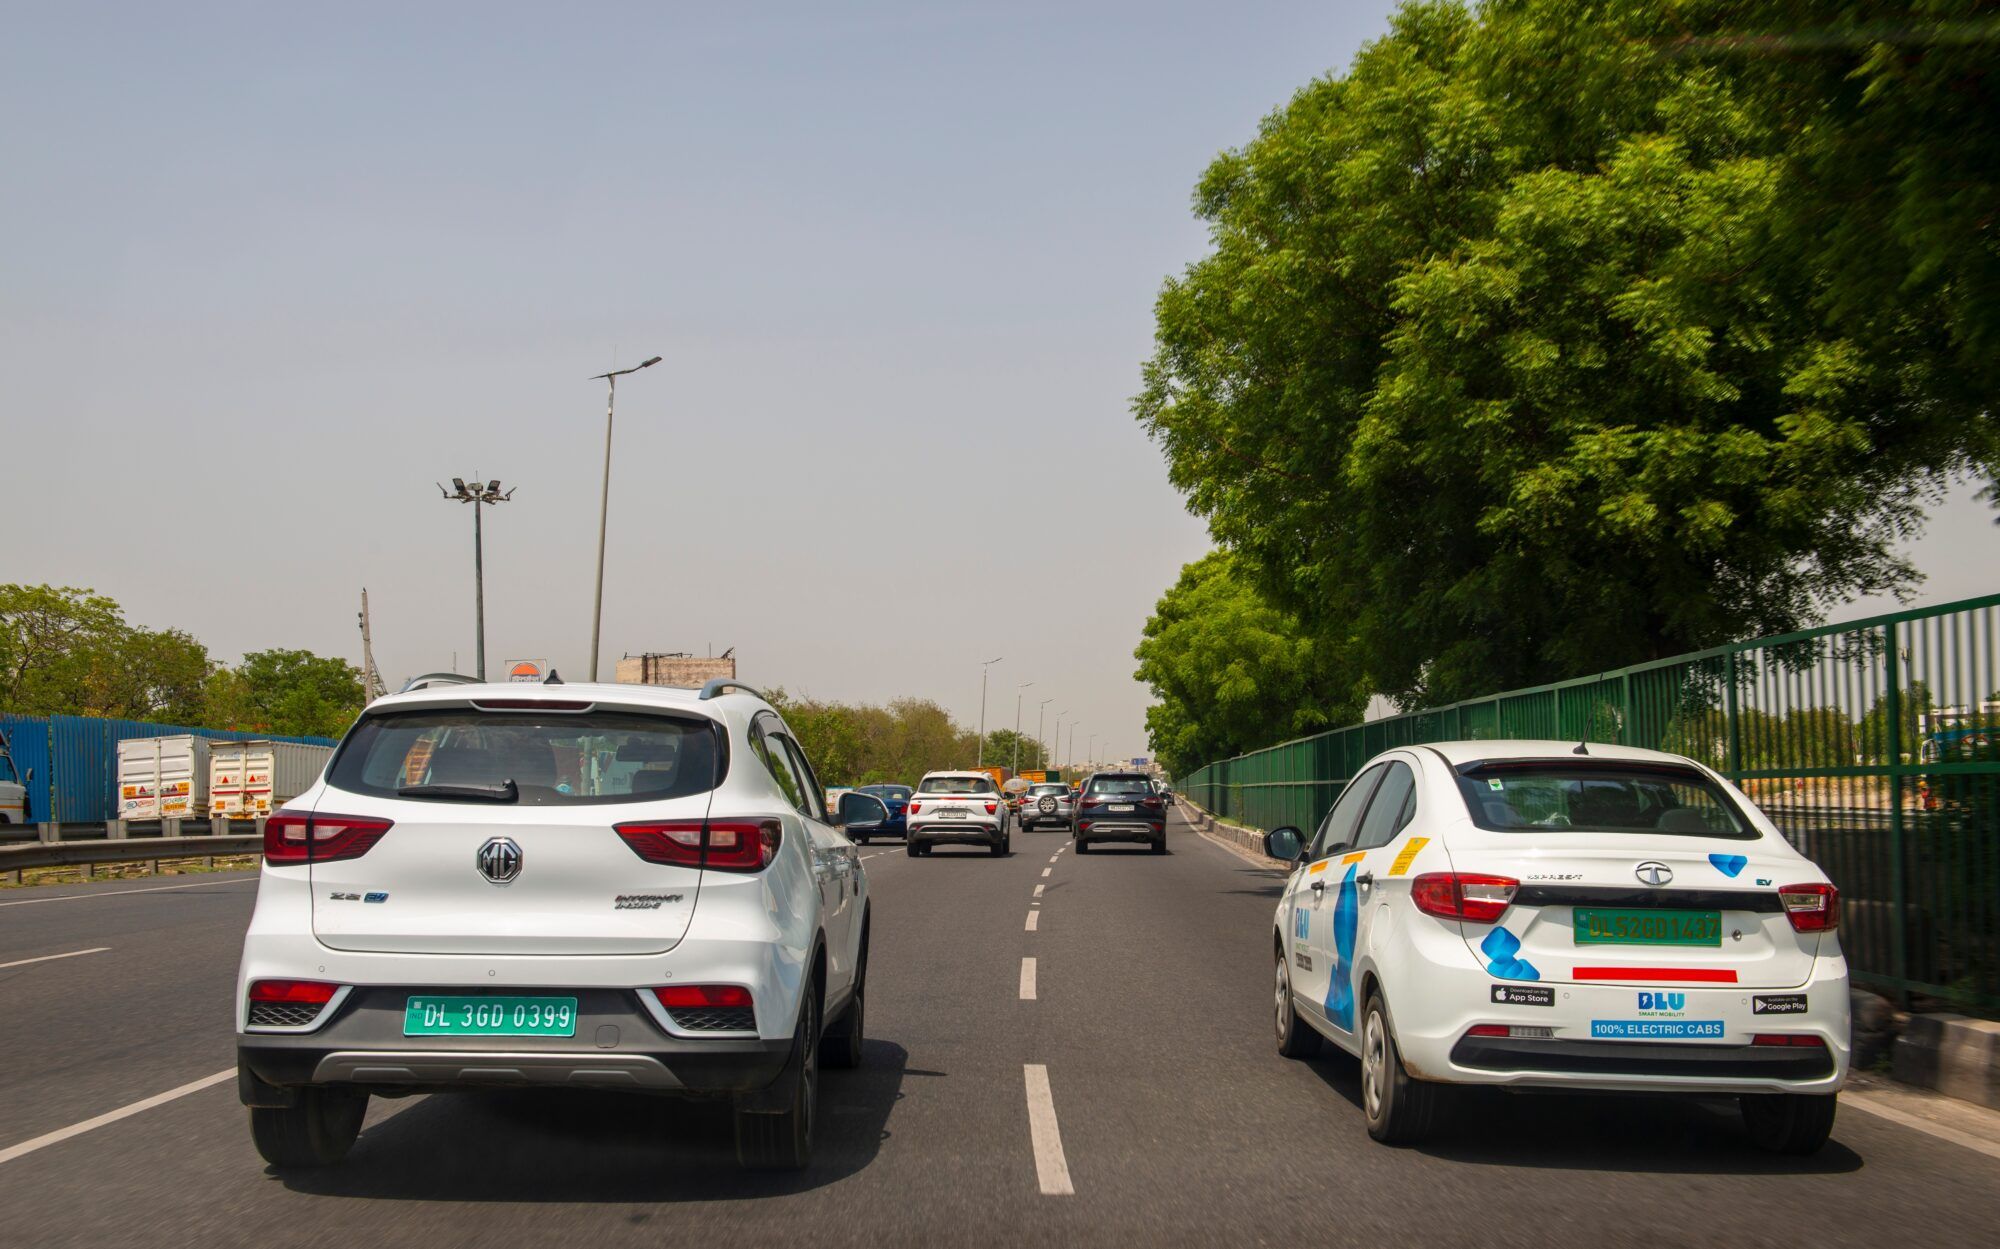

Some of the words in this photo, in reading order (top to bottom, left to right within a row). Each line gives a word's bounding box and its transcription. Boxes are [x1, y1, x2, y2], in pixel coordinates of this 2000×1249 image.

[483, 843, 517, 879] MG
[1509, 994, 1526, 1002] App
[1638, 992, 1685, 1010] BLU
[1767, 1003, 1791, 1011] Google
[1792, 1002, 1806, 1010] Play
[424, 1004, 450, 1027] DL
[460, 1004, 504, 1027] 3GD
[513, 1004, 570, 1028] 0399
[1595, 1024, 1624, 1034] 100%
[1627, 1024, 1684, 1034] ELECTRIC
[1687, 1024, 1721, 1034] CABS
